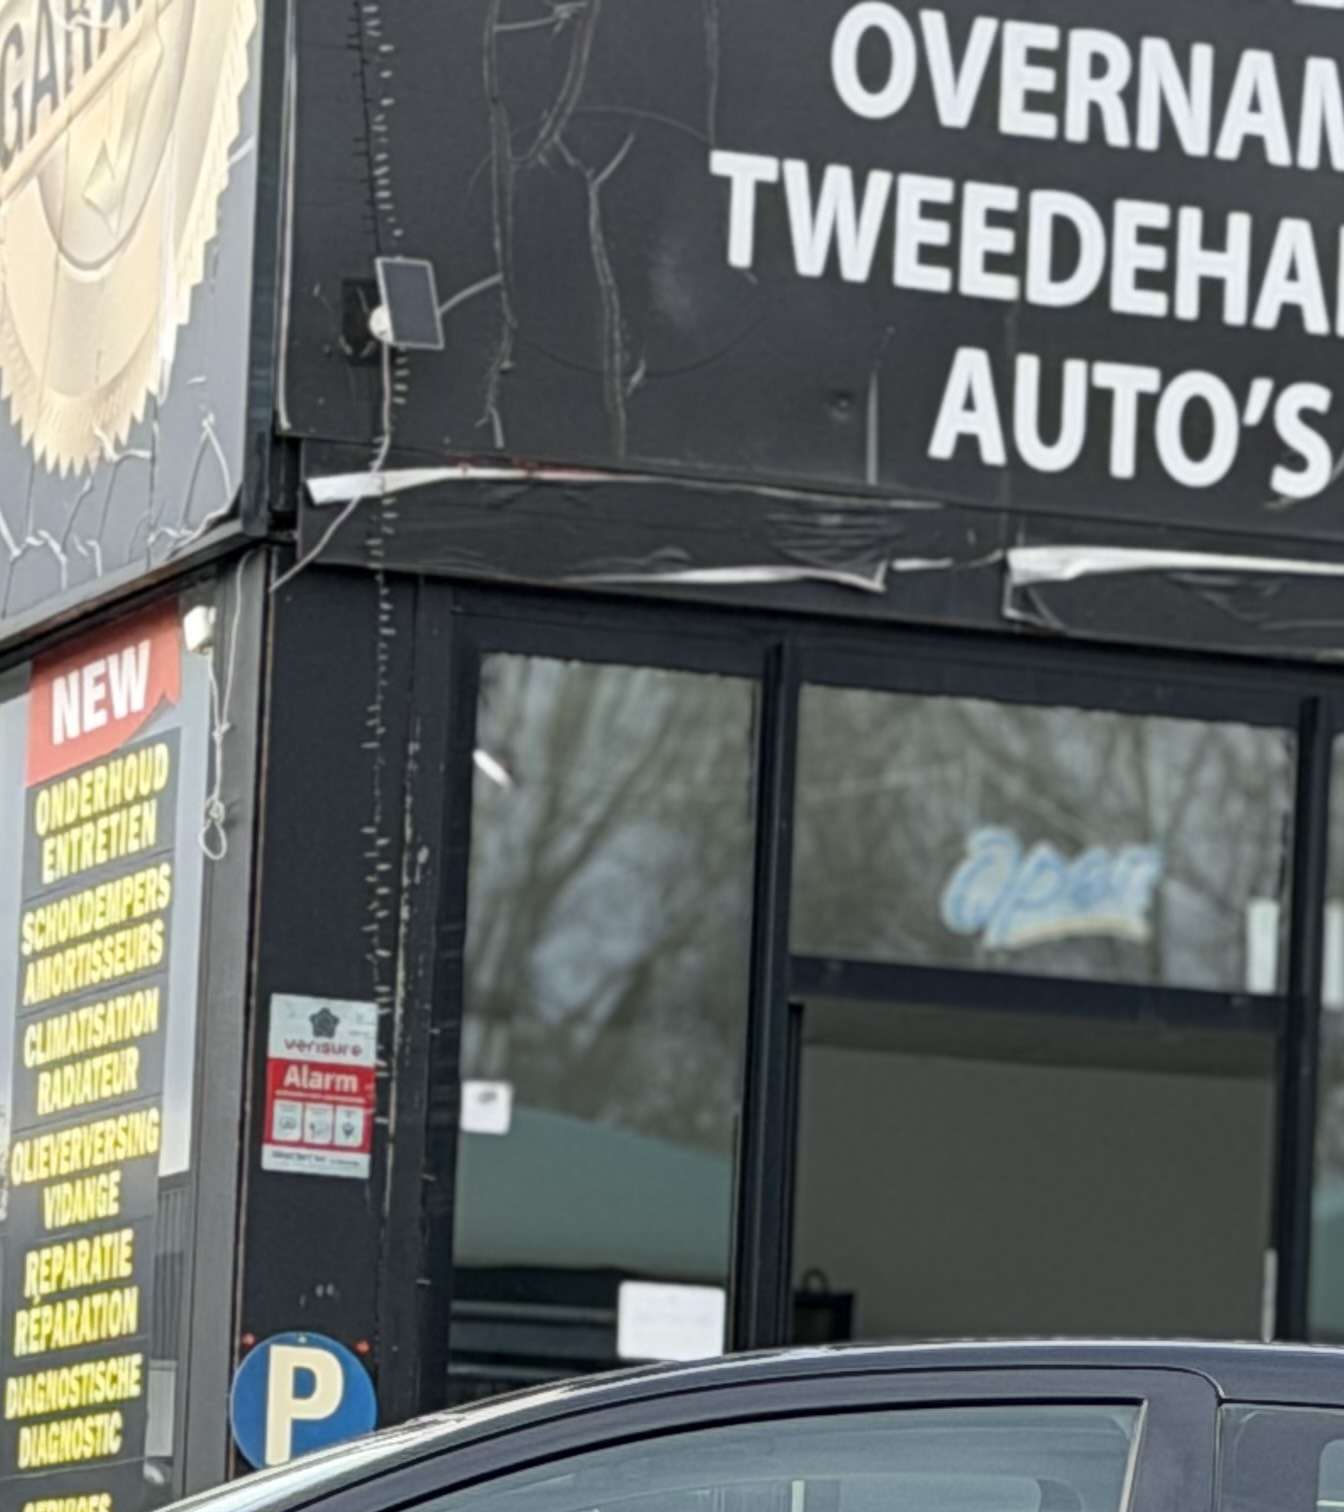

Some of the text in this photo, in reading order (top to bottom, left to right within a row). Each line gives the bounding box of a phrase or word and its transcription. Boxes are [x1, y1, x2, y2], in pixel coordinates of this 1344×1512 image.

[52, 639, 152, 746] NEW
[35, 742, 170, 837] ONDERHOUD
[41, 799, 157, 885] ENTRETIEN
[21, 862, 172, 956] SCHOKDEMPERS
[22, 918, 165, 1007] AMORTISSEURS
[23, 986, 161, 1069] CLIMATISATION
[283, 1037, 363, 1057] verisure
[37, 1046, 140, 1116] RADIATEUR
[283, 1064, 359, 1092] Alarm
[11, 1107, 161, 1186] OLIEVERVERSING
[43, 1169, 122, 1230] VIDANGE
[24, 1228, 135, 1299] REPARATIE
[4, 1353, 145, 1421] DIAGNOSTISCHE
[264, 1343, 345, 1467] P
[17, 1411, 123, 1471] DIAGNOSTIC
